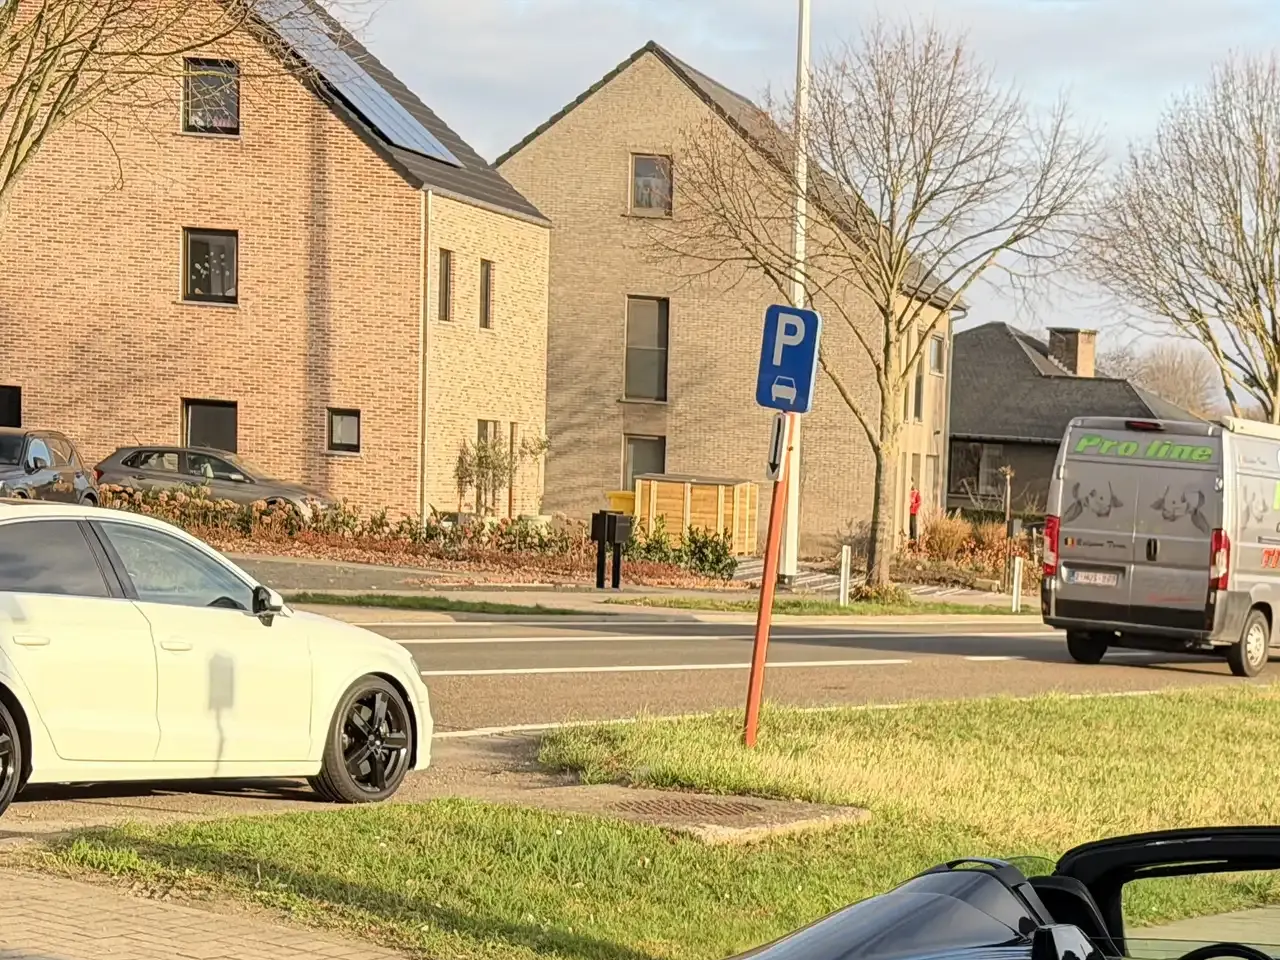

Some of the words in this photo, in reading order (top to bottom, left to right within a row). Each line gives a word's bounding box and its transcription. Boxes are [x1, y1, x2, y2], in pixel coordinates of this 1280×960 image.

[772, 312, 806, 367] P
[1074, 433, 1139, 456] Pro
[1145, 440, 1213, 463] line
